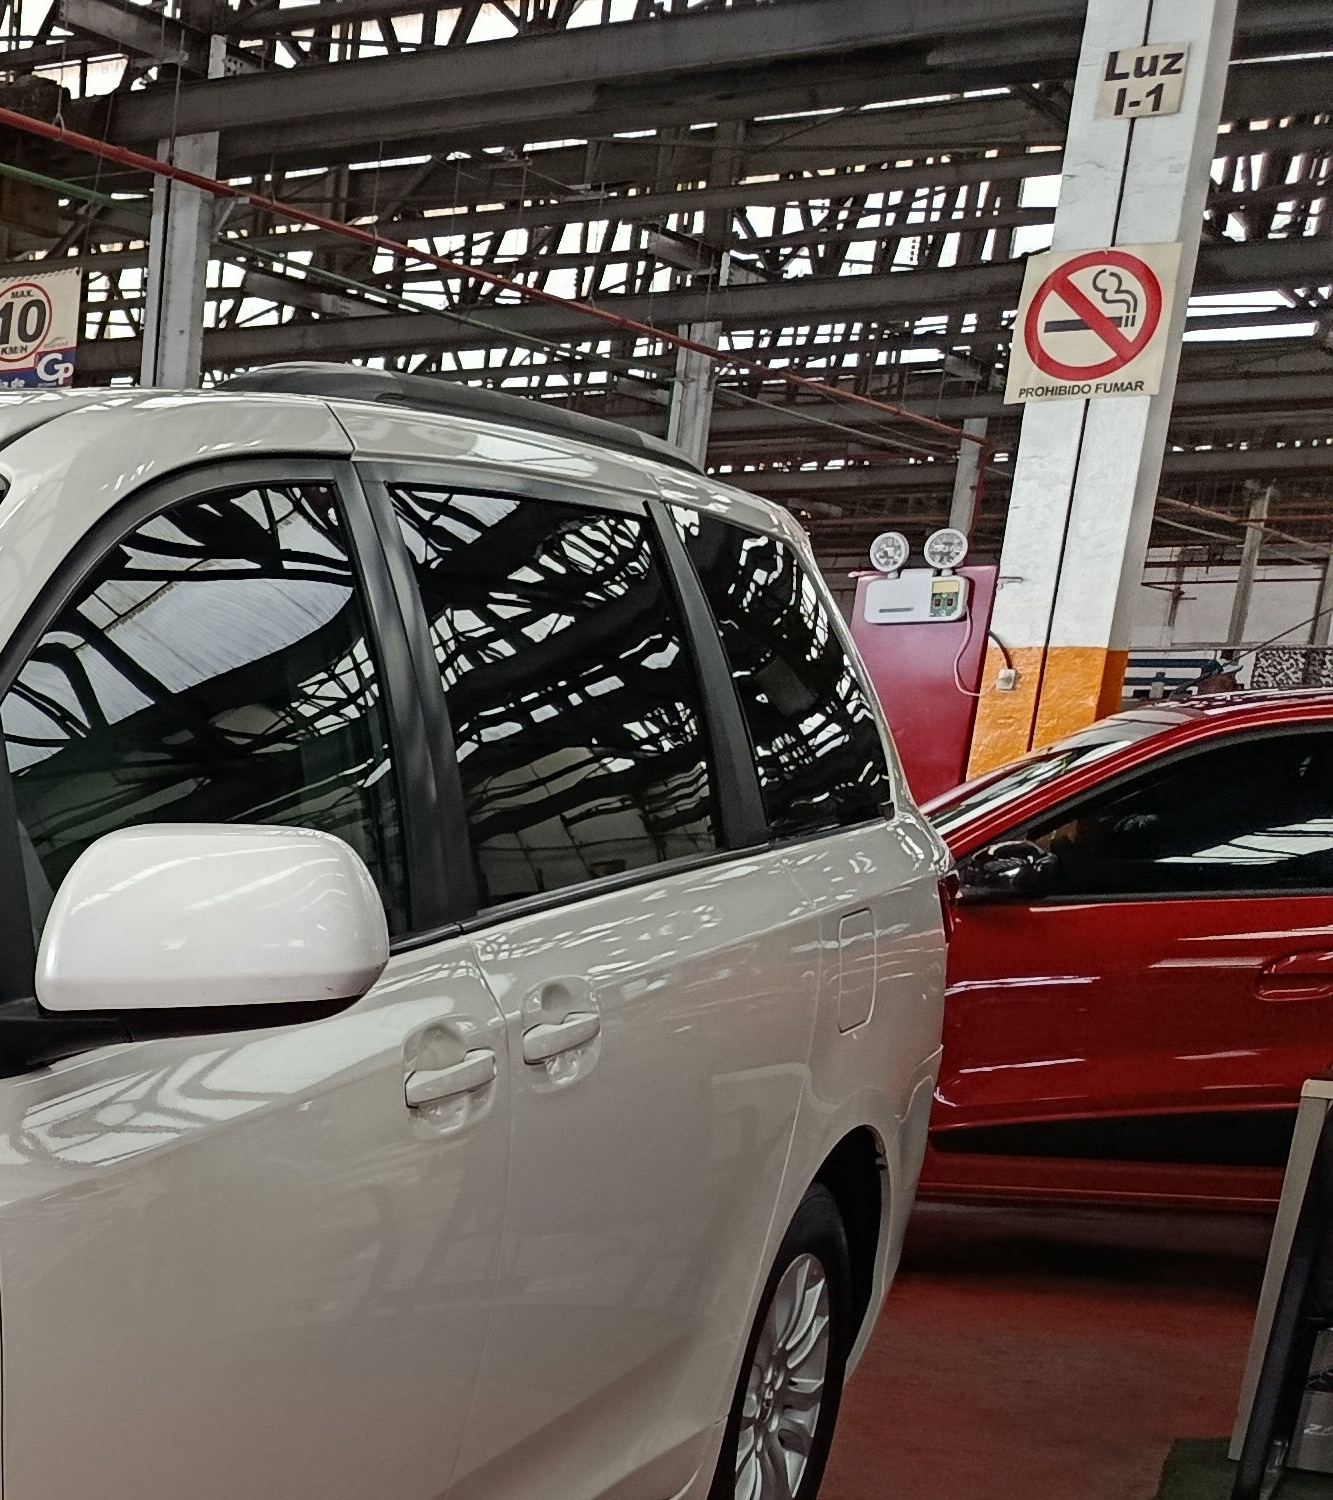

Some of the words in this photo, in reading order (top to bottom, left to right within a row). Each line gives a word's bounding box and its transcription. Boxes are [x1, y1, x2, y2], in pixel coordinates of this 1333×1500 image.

[1104, 51, 1185, 82] Luz
[1114, 83, 1165, 116] I-1
[1018, 383, 1091, 399] PROHIBIDO
[1094, 380, 1144, 394] FUMAR
